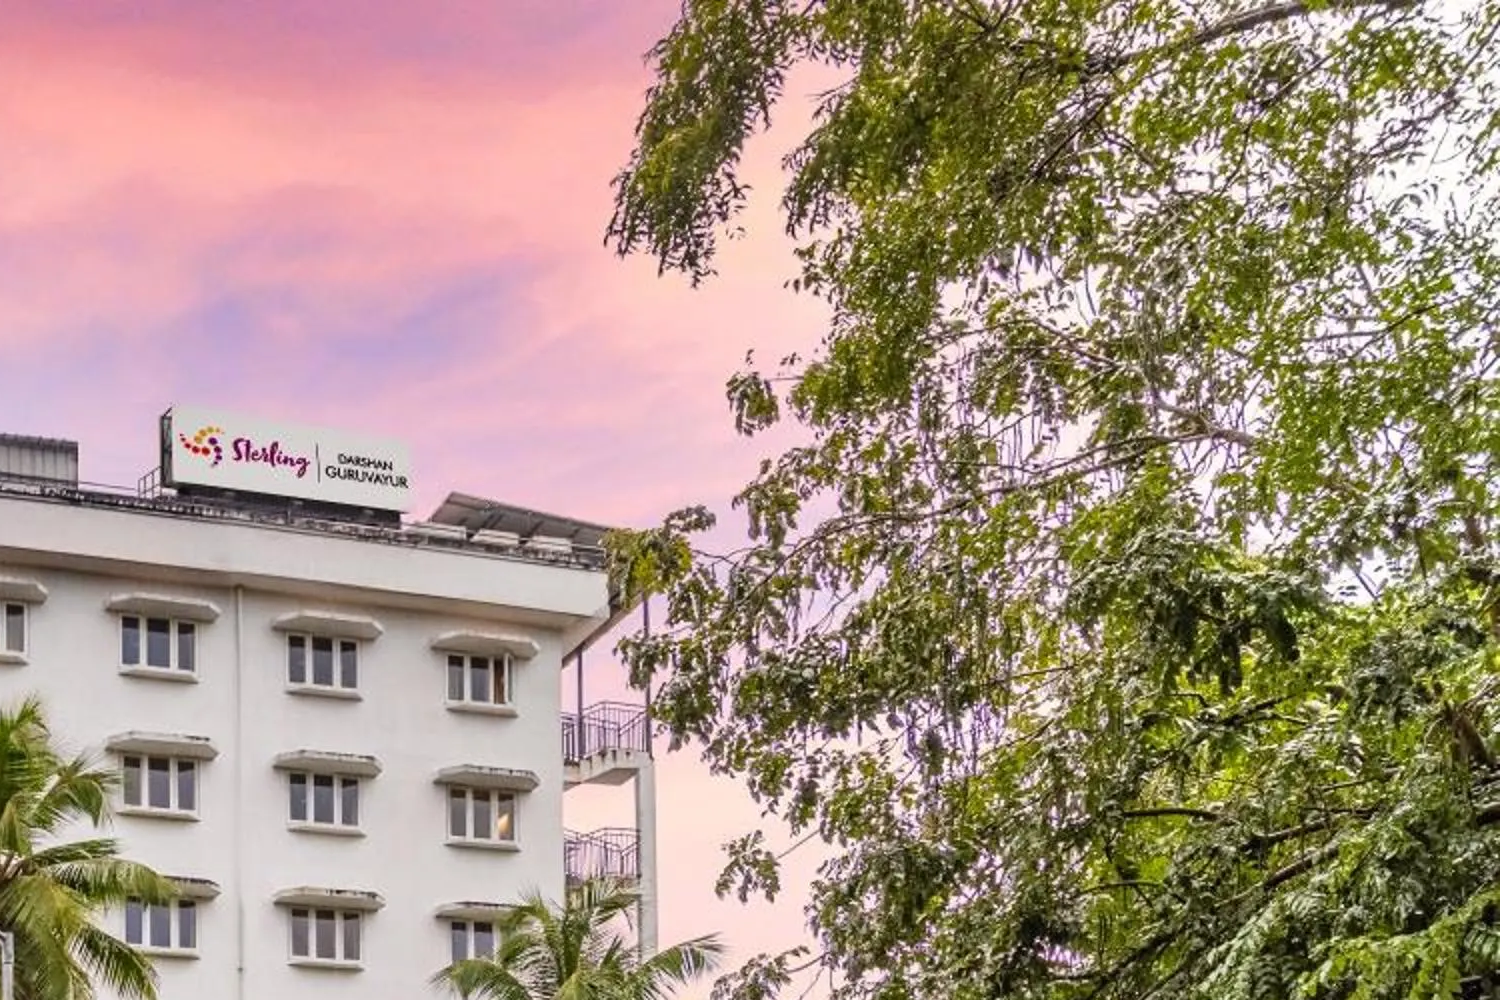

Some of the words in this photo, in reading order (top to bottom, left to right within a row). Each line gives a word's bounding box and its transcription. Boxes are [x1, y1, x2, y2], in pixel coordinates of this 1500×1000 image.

[233, 437, 311, 478] Sterling
[337, 453, 393, 471] DARSHAN
[325, 465, 409, 489] GURUVAYUR
